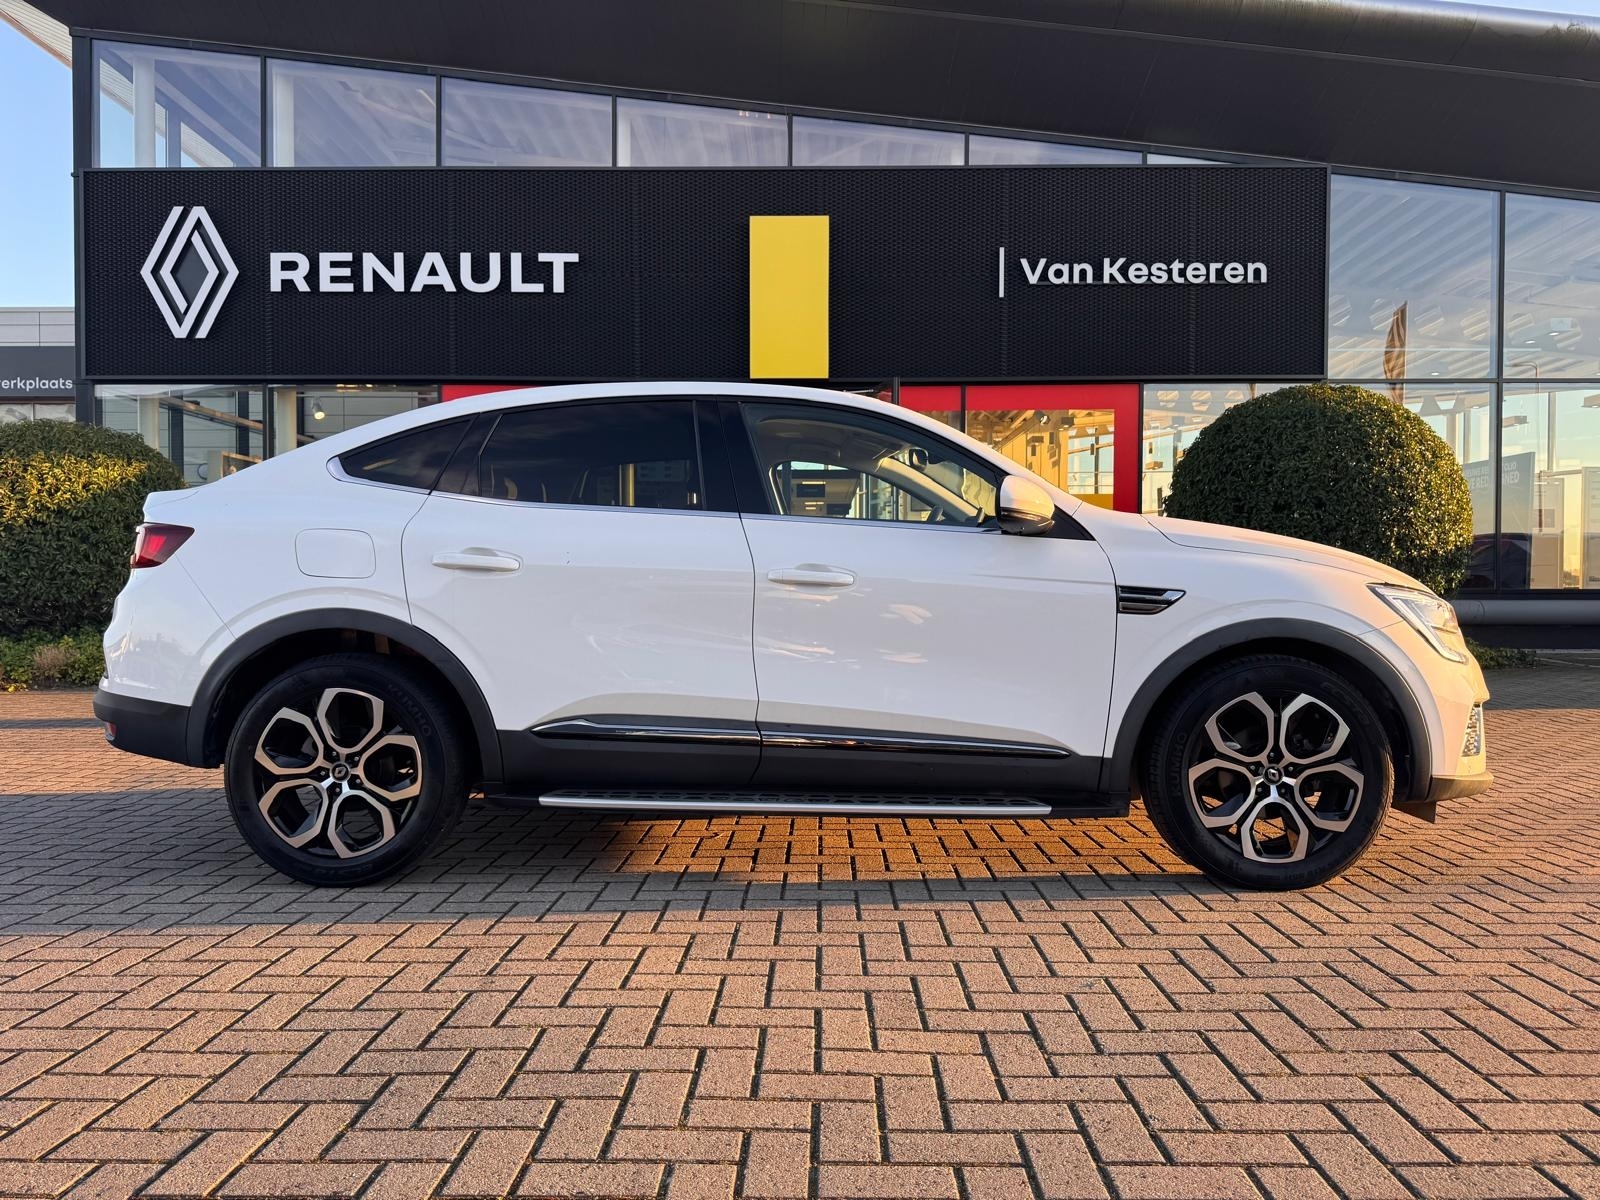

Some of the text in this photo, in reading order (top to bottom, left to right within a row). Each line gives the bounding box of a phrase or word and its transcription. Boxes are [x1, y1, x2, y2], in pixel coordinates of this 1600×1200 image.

[269, 252, 579, 293] RENAULT
[1019, 257, 1268, 285] Van Kesteren
[0, 376, 73, 392] erkplaats
